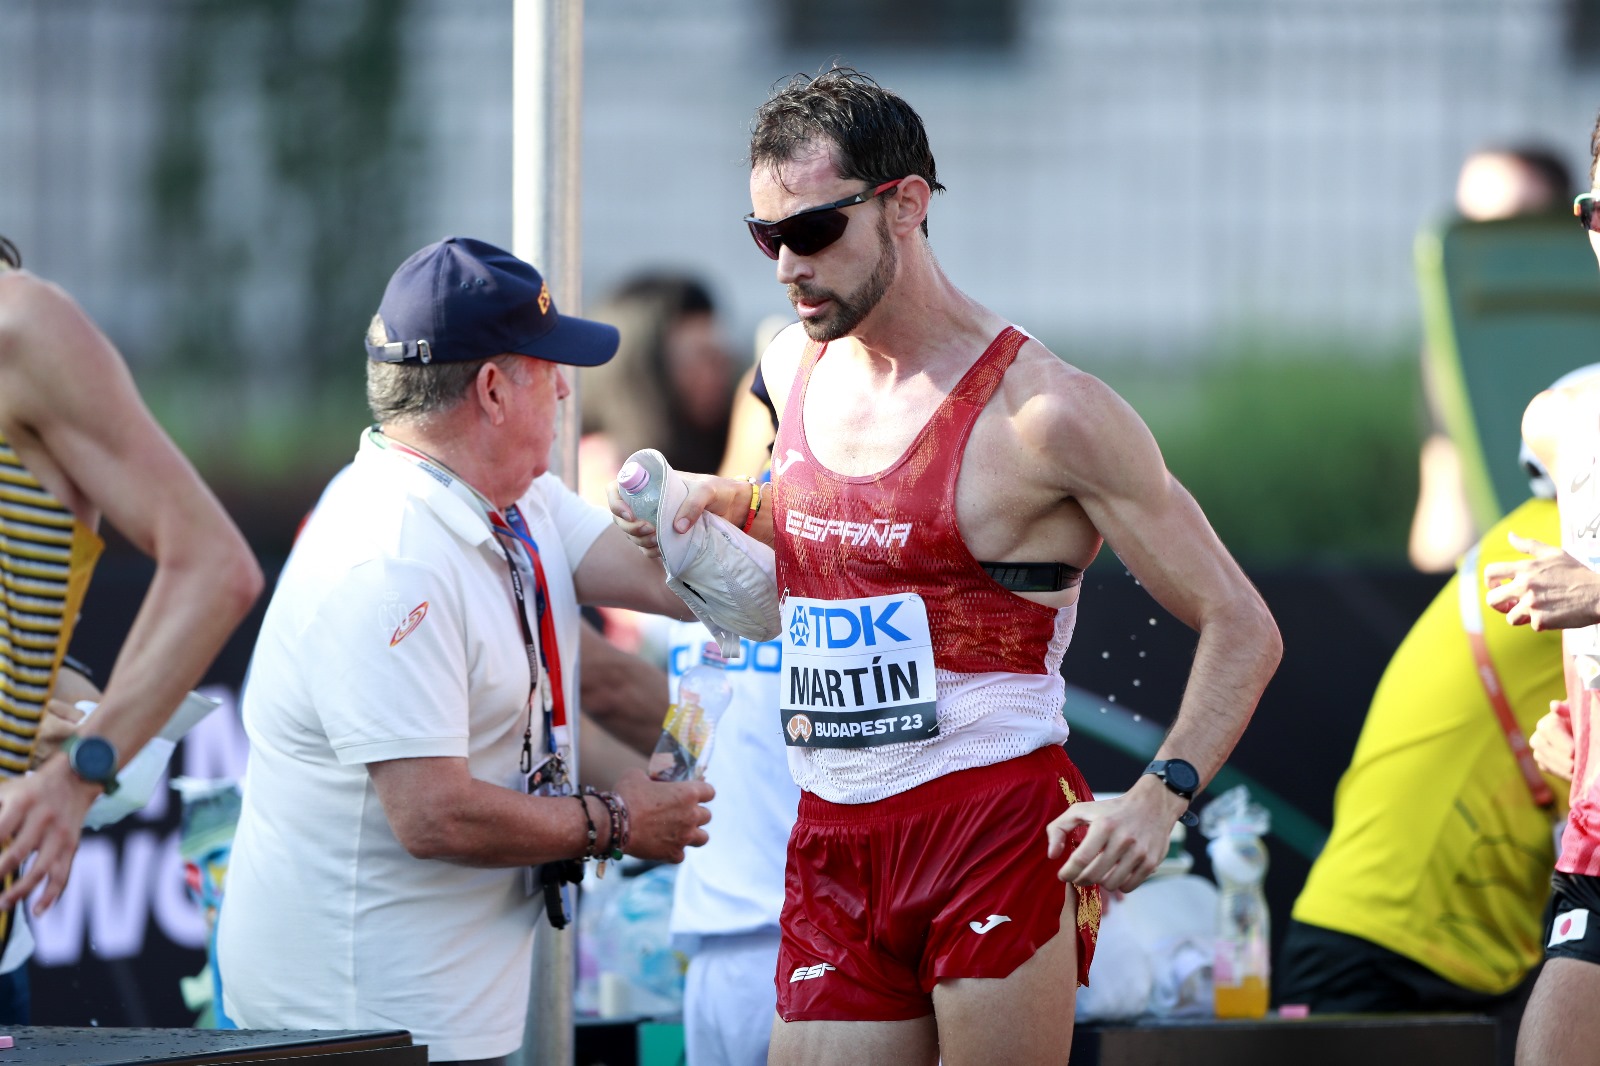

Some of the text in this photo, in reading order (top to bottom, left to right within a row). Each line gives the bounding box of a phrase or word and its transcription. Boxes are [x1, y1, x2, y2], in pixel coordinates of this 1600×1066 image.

[785, 509, 913, 548] ESPAÑA
[808, 600, 912, 649] TDK
[790, 655, 920, 708] MARTÍN
[814, 713, 923, 738] BUDAPEST 23
